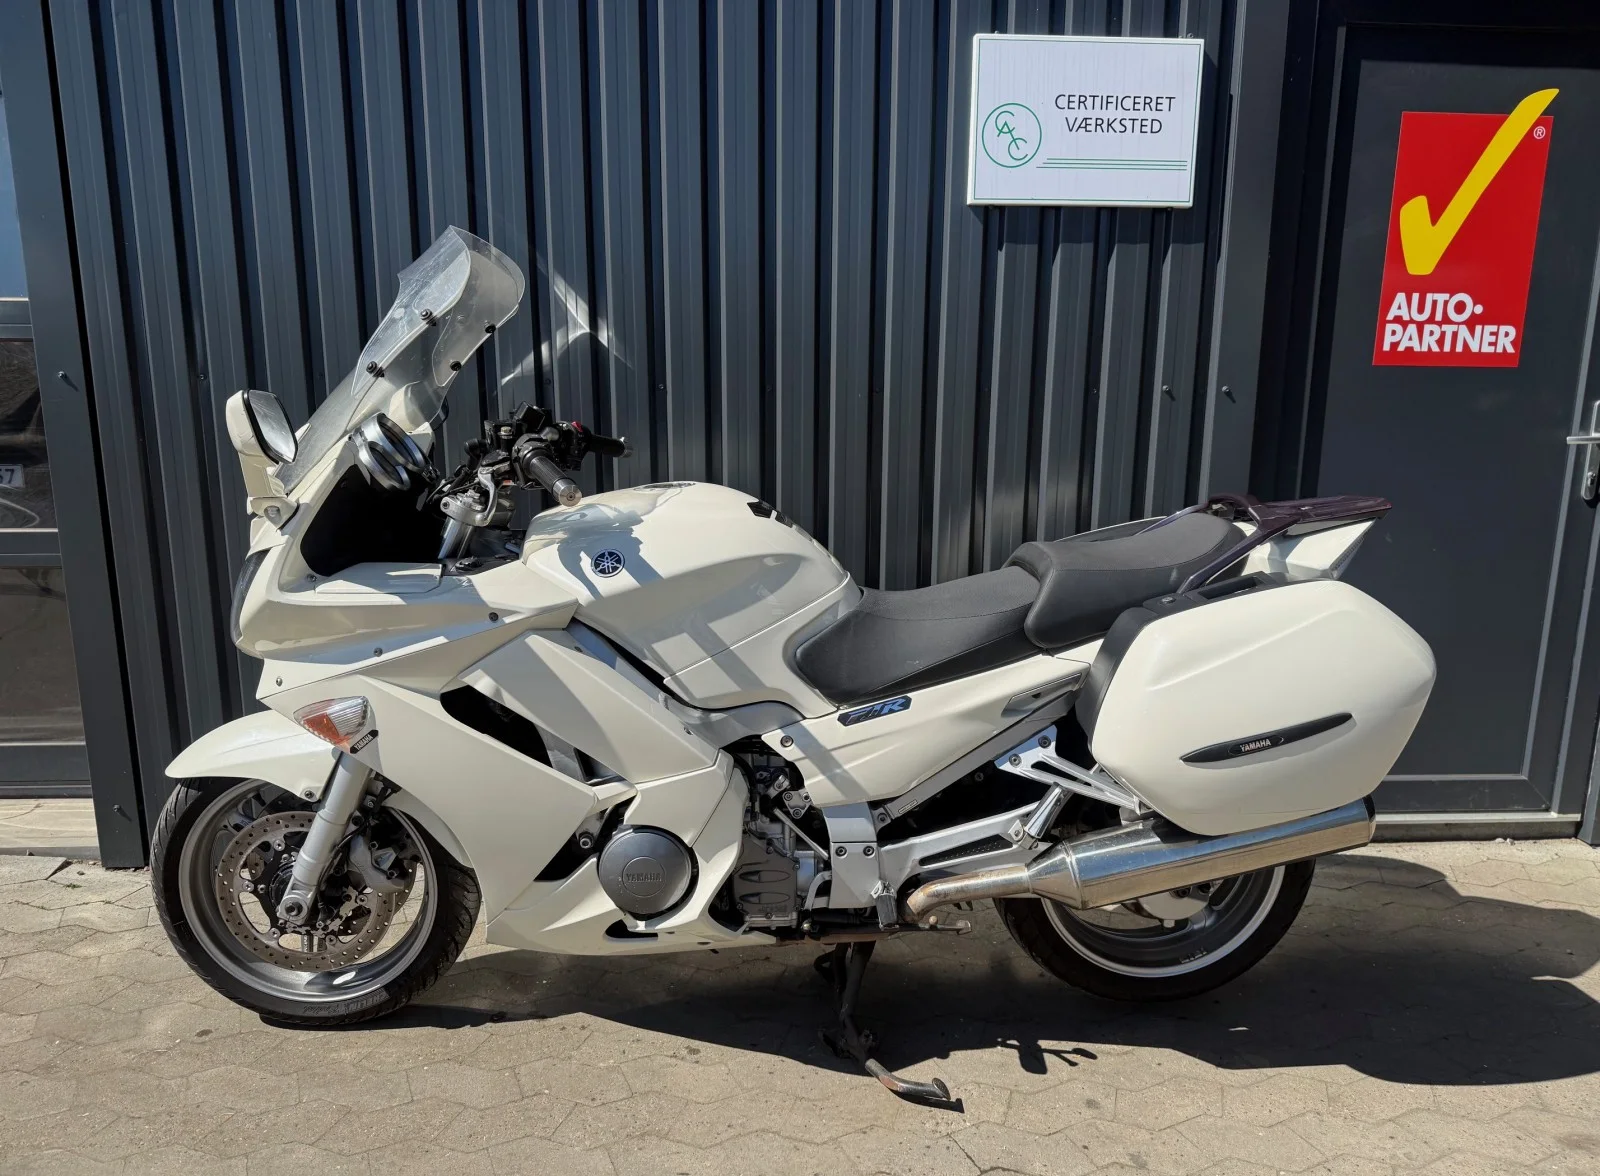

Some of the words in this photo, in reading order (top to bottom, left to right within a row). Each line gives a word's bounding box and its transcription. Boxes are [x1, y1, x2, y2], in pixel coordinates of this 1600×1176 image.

[1055, 94, 1175, 112] CERTIFICERET
[1065, 117, 1163, 134] VÆRKSTED
[1383, 323, 1517, 353] PARTNER
[353, 733, 374, 750] YAMAHA
[1239, 738, 1272, 752] YAMAHA
[626, 872, 661, 883] YAMAHA
